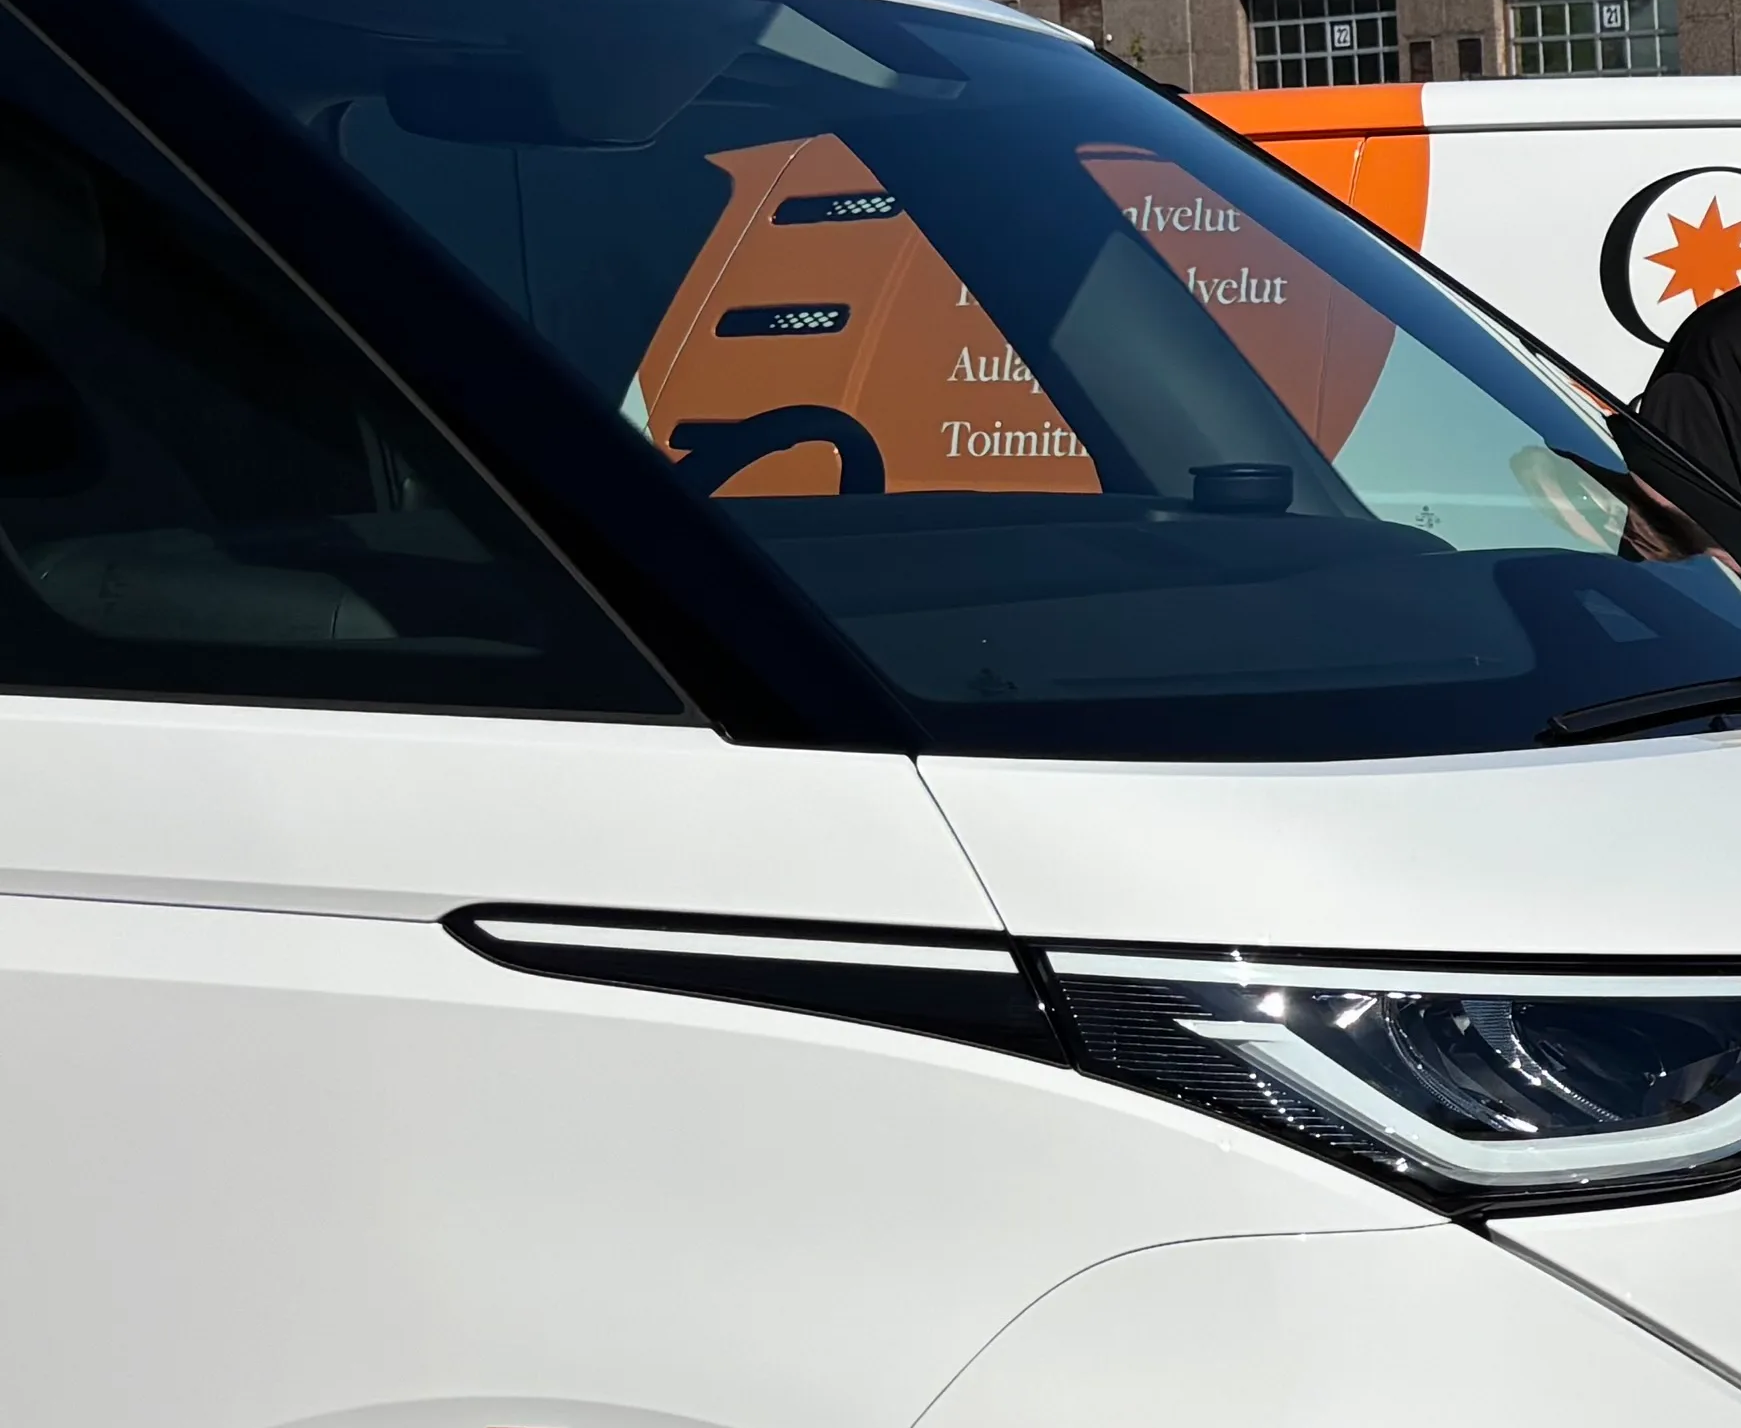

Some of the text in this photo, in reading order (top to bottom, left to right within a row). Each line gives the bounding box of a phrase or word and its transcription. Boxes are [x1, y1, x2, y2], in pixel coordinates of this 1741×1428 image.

[1606, 7, 1618, 24] 21
[1336, 27, 1349, 44] 22
[947, 343, 1042, 395] Aula
